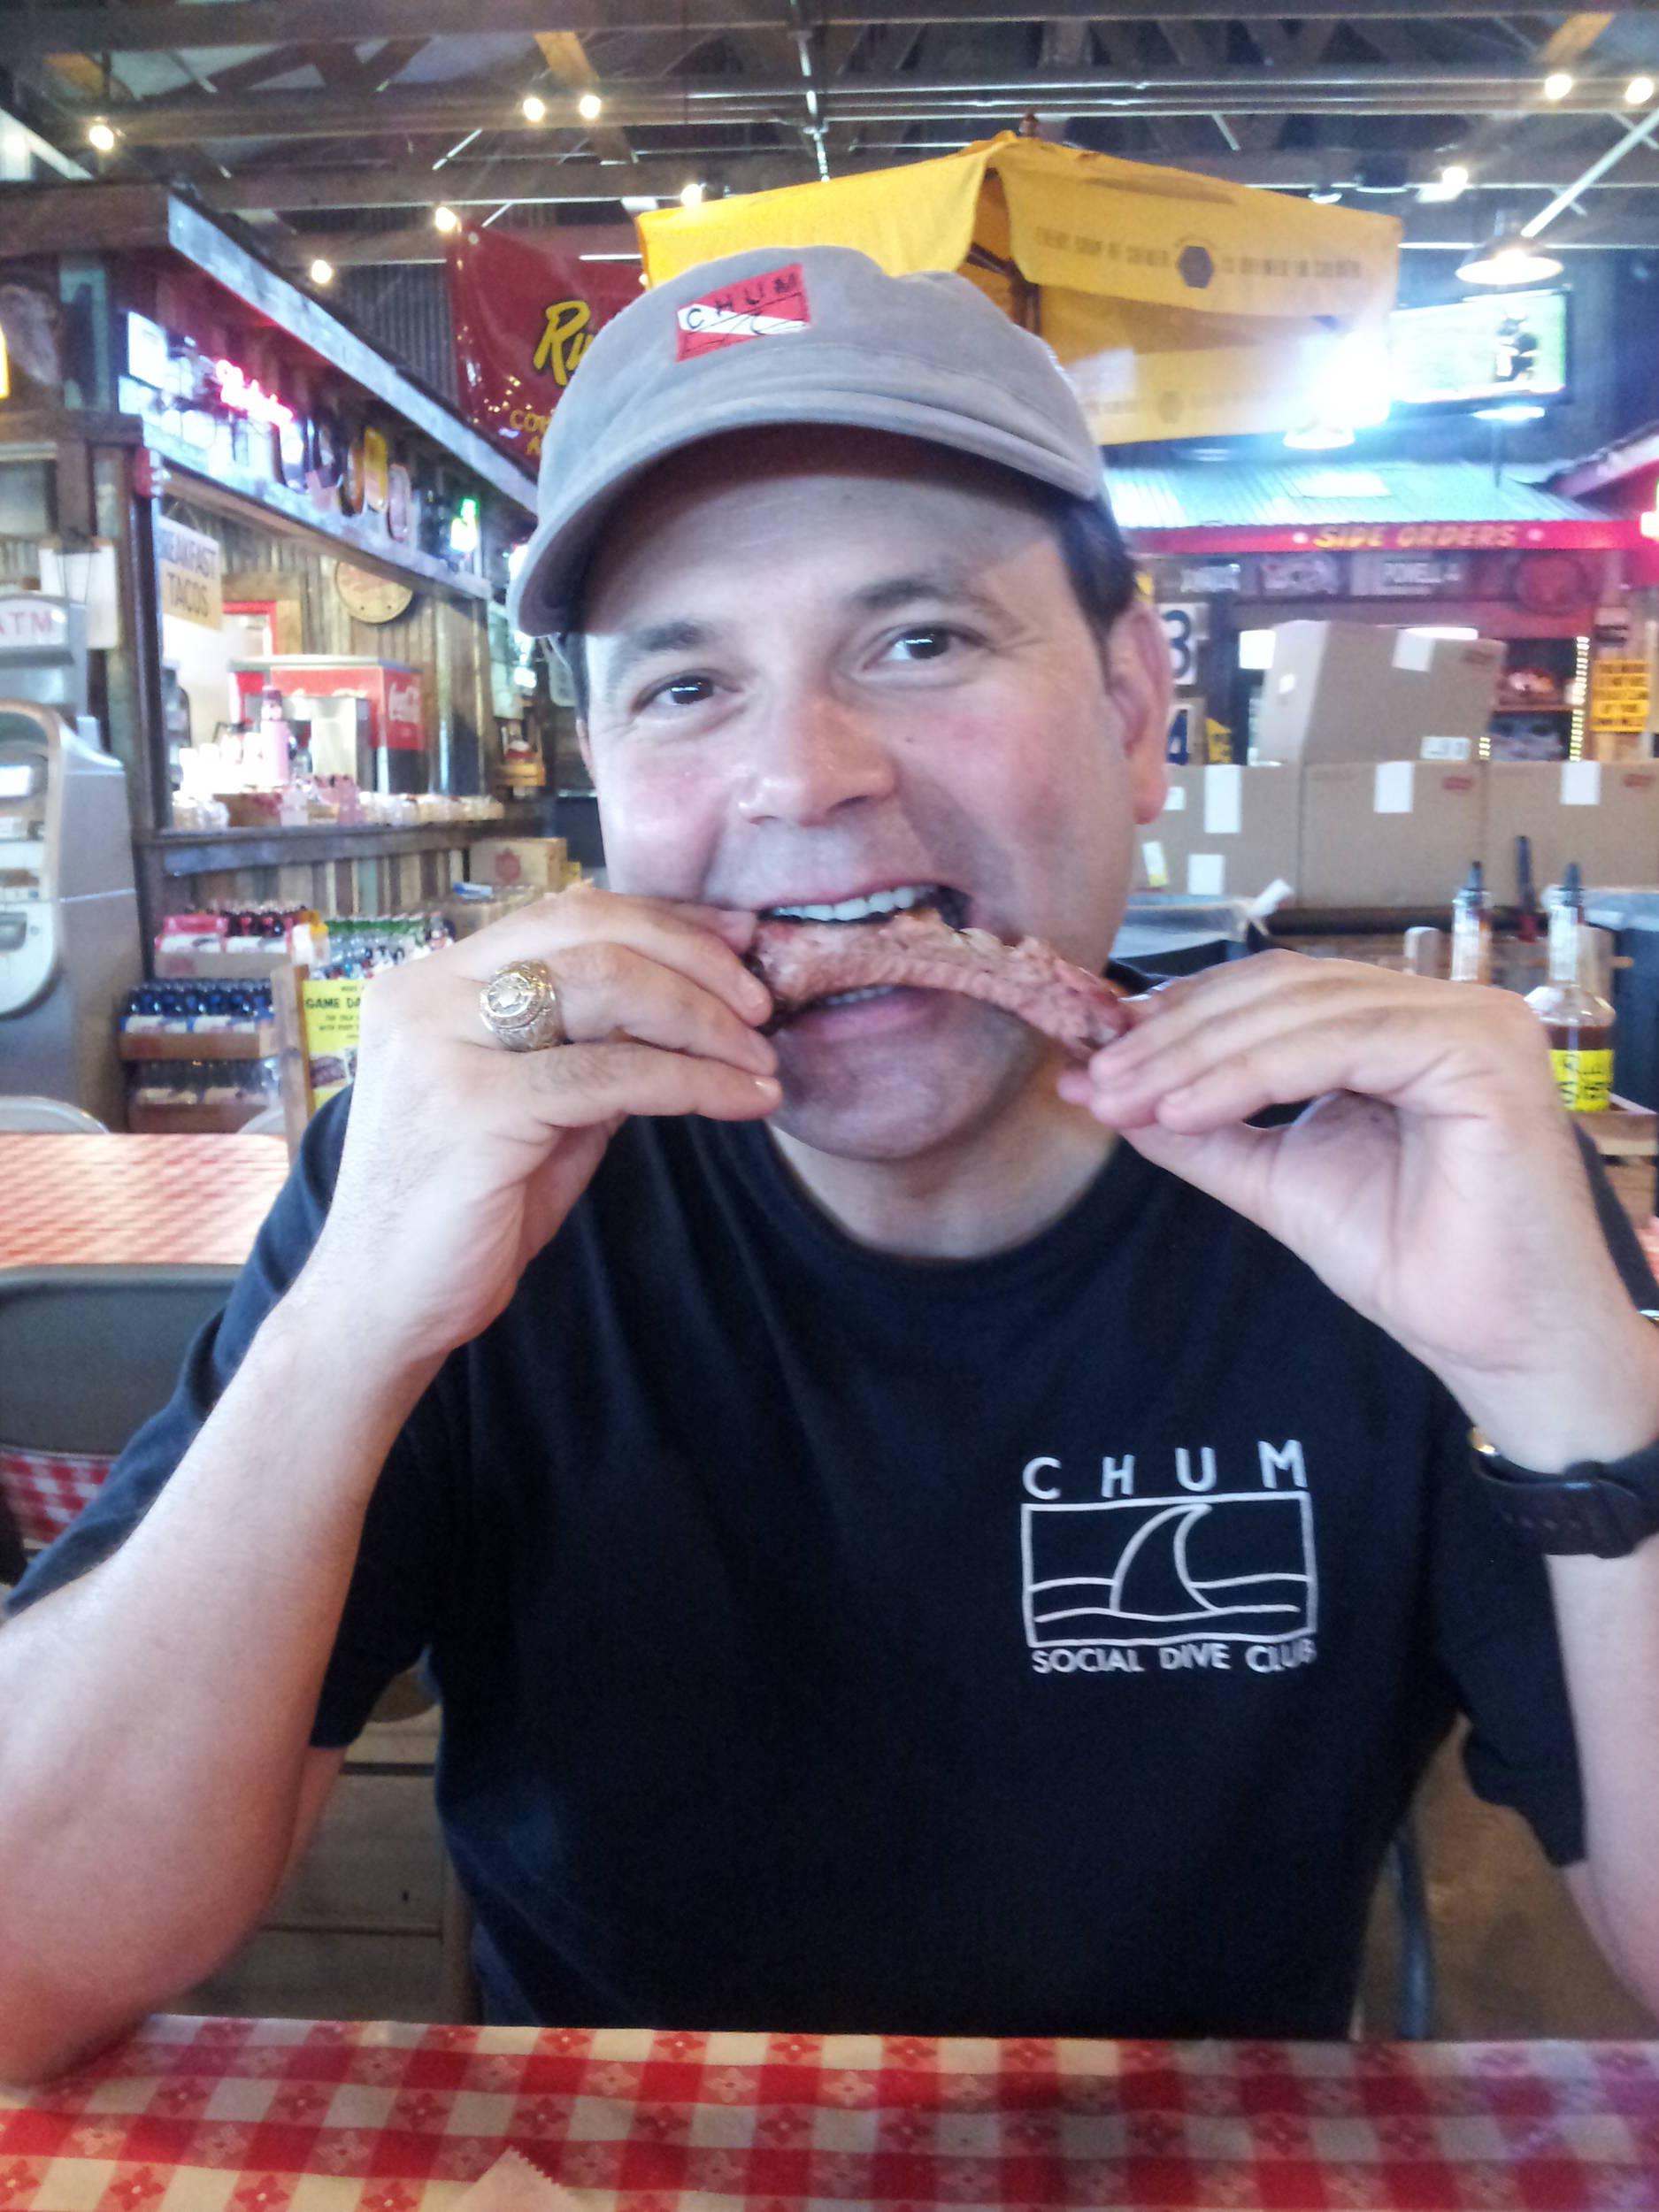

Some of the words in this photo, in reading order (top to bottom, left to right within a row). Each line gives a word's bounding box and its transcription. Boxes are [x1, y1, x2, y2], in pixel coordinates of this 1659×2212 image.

[686, 273, 797, 330] CHUM
[533, 299, 596, 388] Ru
[1313, 524, 1386, 549] SIDE
[166, 571, 210, 618] TACOS
[0, 611, 53, 635] TM
[304, 997, 340, 1010] GAME
[346, 996, 361, 1009] DA
[1022, 1439, 1308, 1500] CHUM
[1031, 1647, 1146, 1674] SOCIAL
[1159, 1643, 1233, 1671] DIVE
[1244, 1638, 1317, 1673] CLUB
